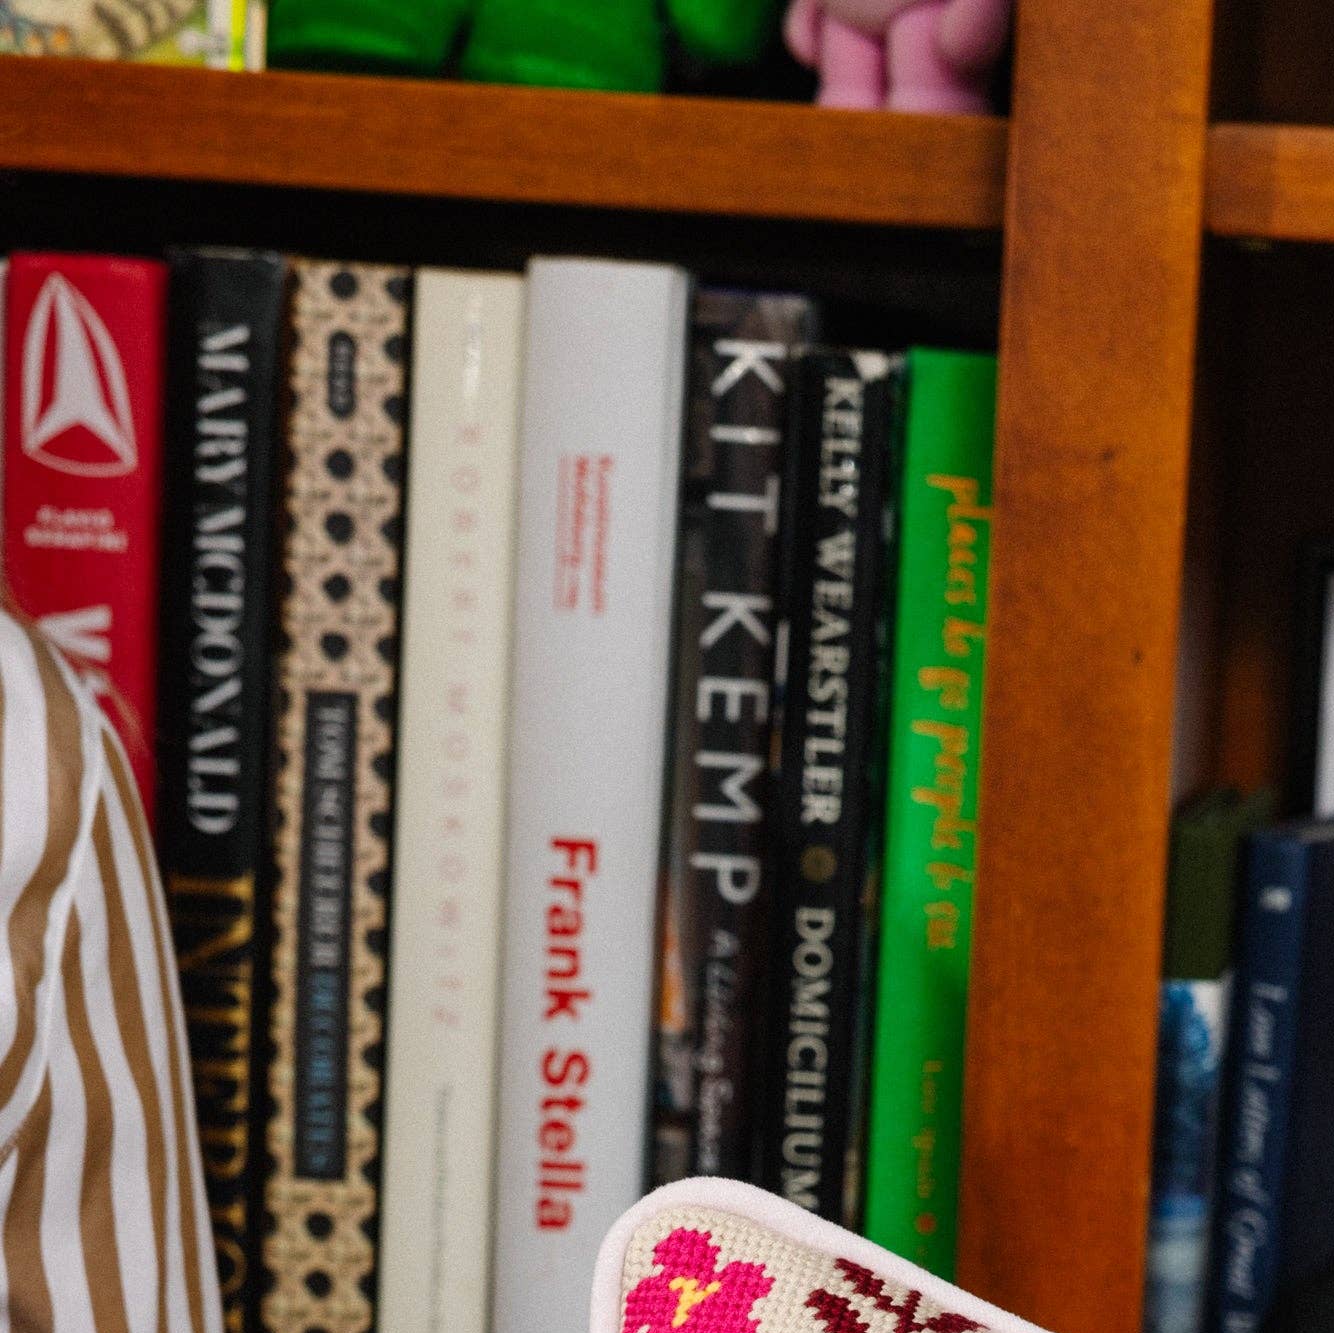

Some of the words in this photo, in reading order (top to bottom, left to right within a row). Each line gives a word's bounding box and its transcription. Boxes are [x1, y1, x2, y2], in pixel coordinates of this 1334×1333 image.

[195, 322, 251, 500] MARY
[708, 339, 786, 535] KIT
[818, 375, 865, 518] KELLY
[187, 504, 248, 836] MCDONALD
[801, 532, 856, 824] WEARSTLER
[917, 665, 970, 710] go
[942, 617, 986, 657] to
[315, 704, 347, 780] TOM
[691, 590, 772, 904] KEMP
[543, 836, 598, 1021] Frank
[535, 1049, 590, 1232] Stella
[781, 906, 835, 1212] DOMICILIUM
